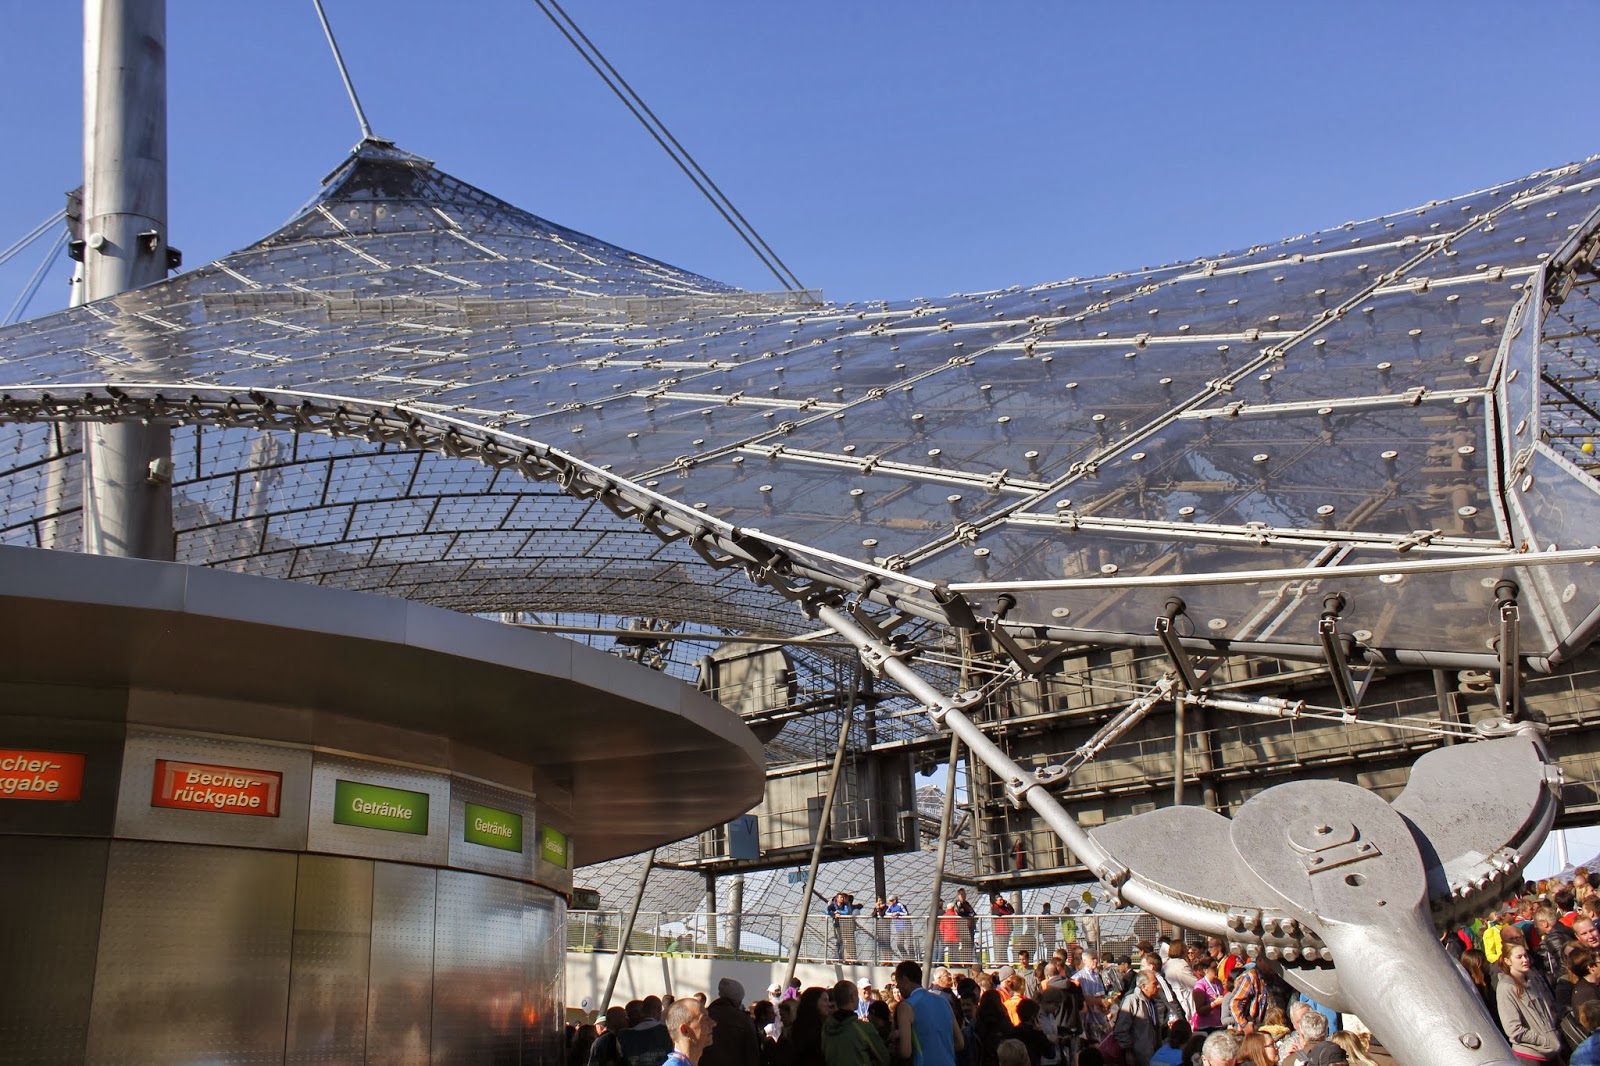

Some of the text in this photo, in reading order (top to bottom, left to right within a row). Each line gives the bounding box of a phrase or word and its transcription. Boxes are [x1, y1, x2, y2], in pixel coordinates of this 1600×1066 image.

[0, 755, 62, 773] cher-
[185, 769, 262, 789] Becher-
[174, 786, 261, 808] rückgabe
[352, 797, 413, 820] Getränke
[474, 817, 513, 838] Getränke
